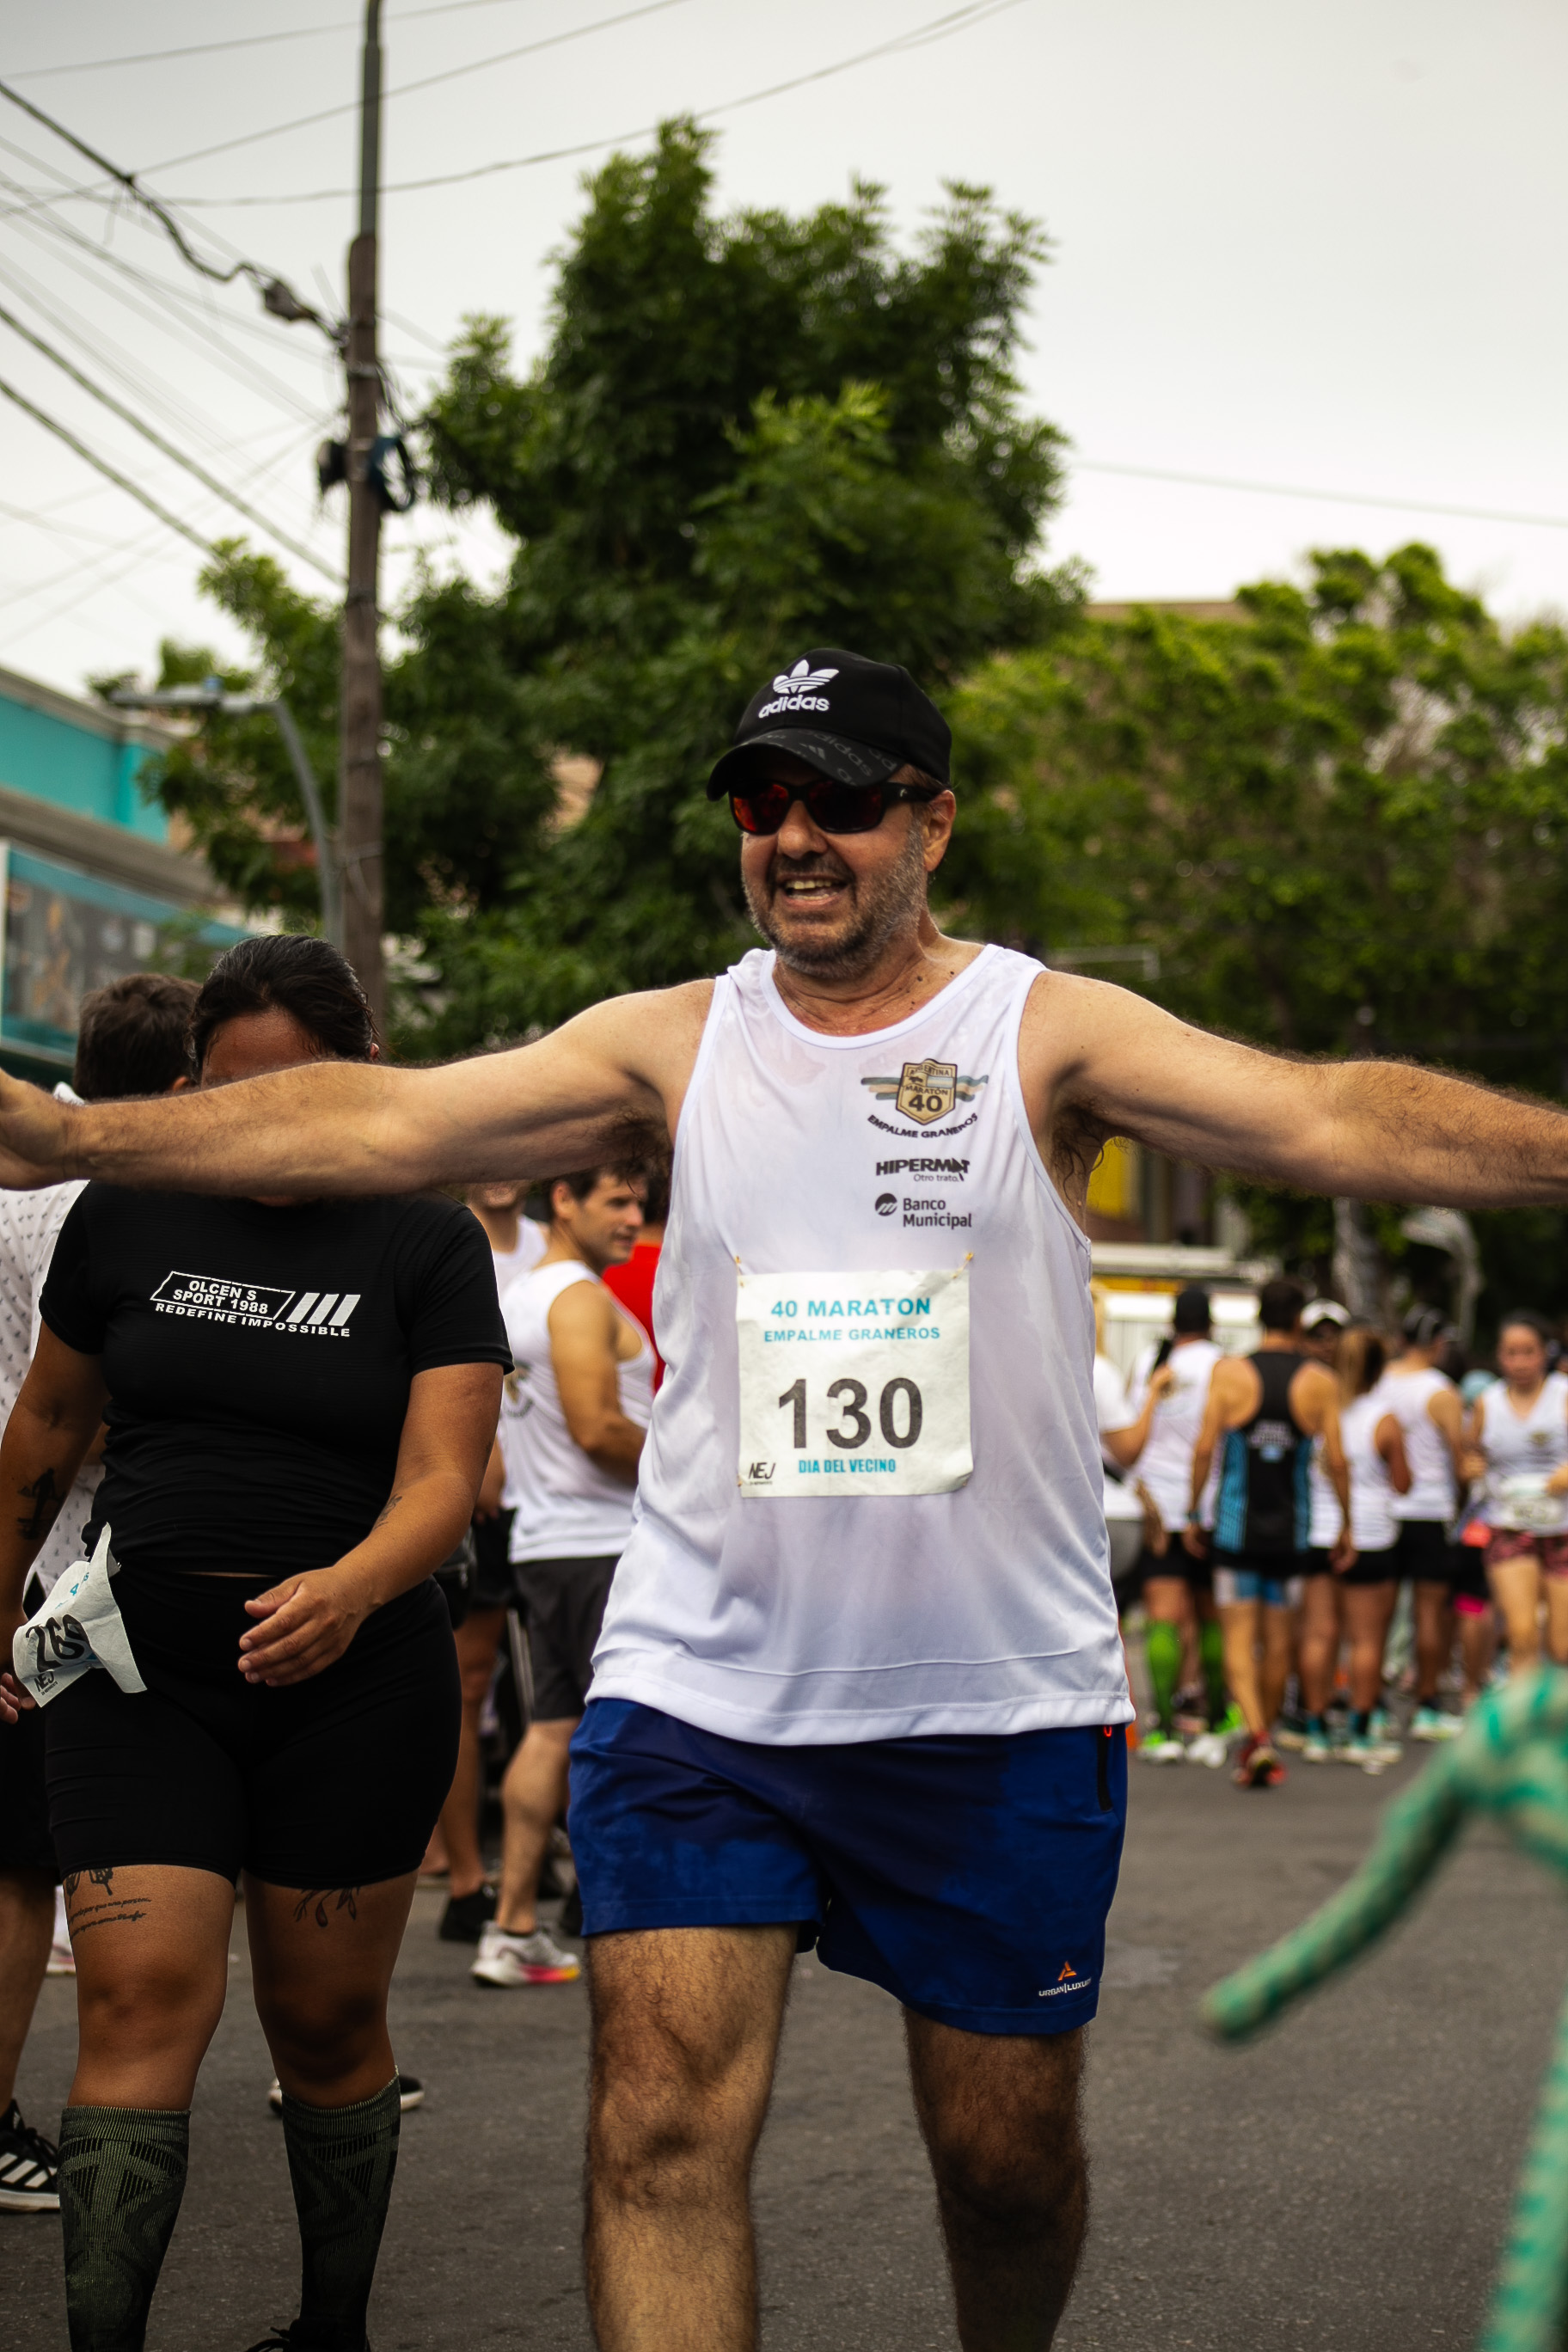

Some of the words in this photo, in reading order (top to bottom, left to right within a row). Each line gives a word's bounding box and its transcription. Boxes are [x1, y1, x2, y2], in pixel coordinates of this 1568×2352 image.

[758, 695, 830, 718] adidas
[910, 1064, 950, 1075] ARGENTINA
[905, 1085, 948, 1095] MARATÓN
[908, 1094, 943, 1112] 40
[867, 1114, 919, 1138] EMPALME
[921, 1112, 978, 1138] GRANEROS
[913, 1173, 934, 1182] Otro
[903, 1197, 946, 1211] Banco
[903, 1213, 972, 1230] Municipal
[188, 1280, 242, 1299] OLCEN
[246, 1289, 257, 1302] S
[172, 1289, 225, 1307] SPORT
[230, 1298, 269, 1315] 1988
[770, 1299, 799, 1318] 40
[806, 1297, 932, 1317] MARATON
[155, 1302, 237, 1325] REDEFINE
[241, 1316, 351, 1338] IMPOSSIBLE
[763, 1329, 842, 1343] EMPALME
[848, 1326, 940, 1340] GRANEROS
[778, 1377, 923, 1449] 130
[748, 1461, 776, 1479] NEJ
[798, 1460, 821, 1473] DIA
[824, 1460, 846, 1473] DEL
[848, 1459, 897, 1473] VECINO
